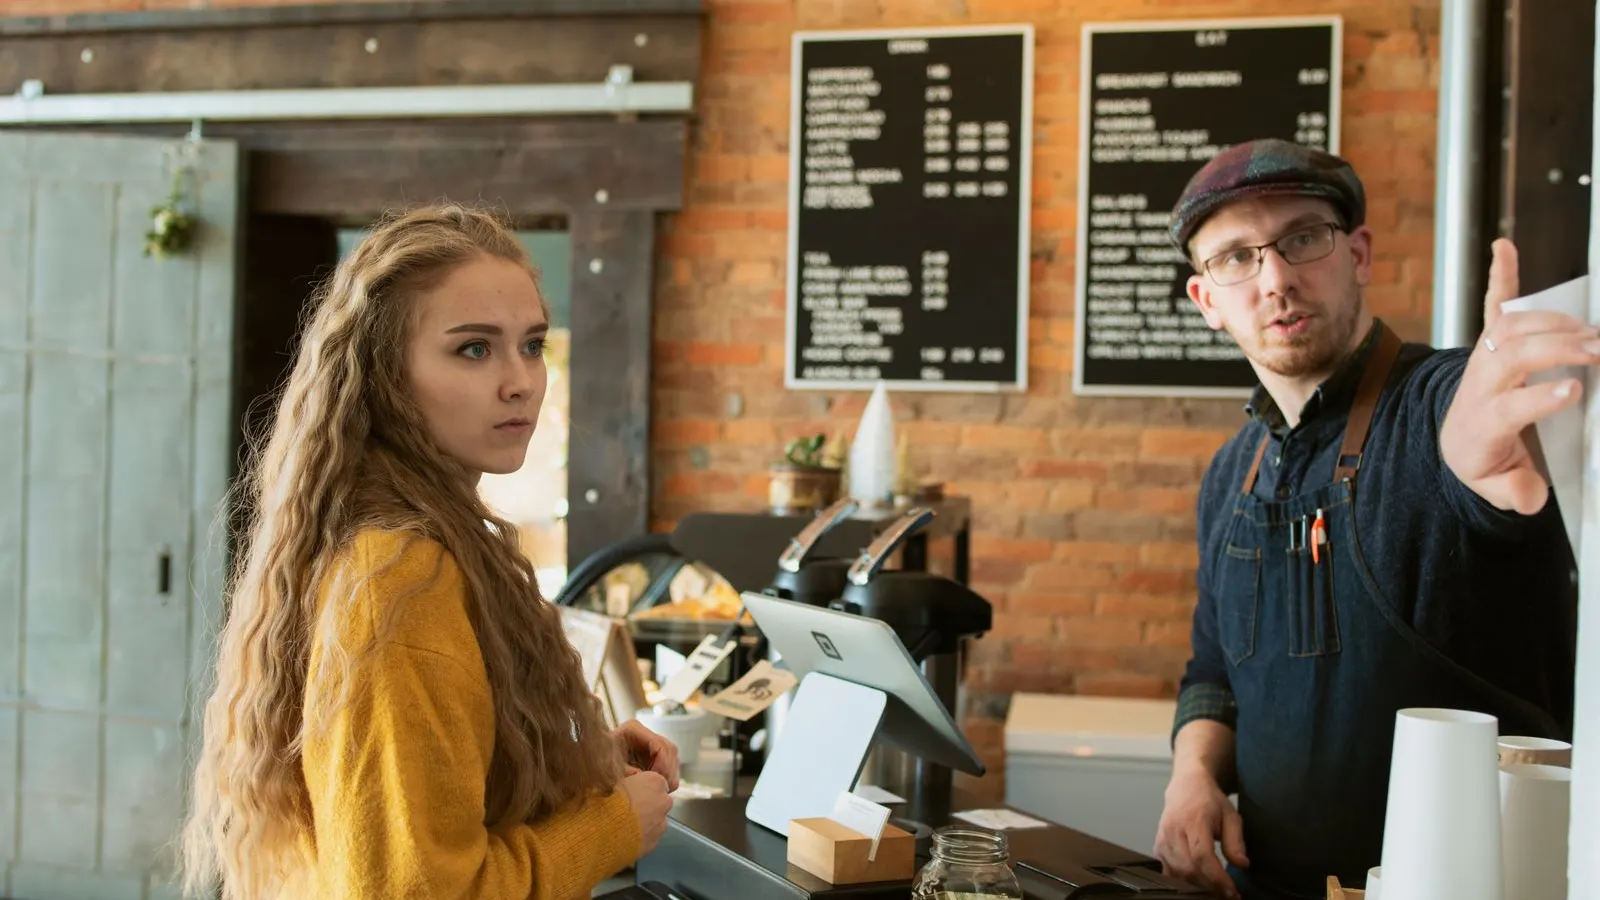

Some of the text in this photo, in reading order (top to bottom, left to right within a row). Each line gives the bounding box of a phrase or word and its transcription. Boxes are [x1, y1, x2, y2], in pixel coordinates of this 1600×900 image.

[1096, 73, 1168, 89] BREAKFAST
[1172, 71, 1241, 87] SANDWICH
[1162, 130, 1209, 145] TOAST
[1090, 265, 1177, 280] SANDWICHES
